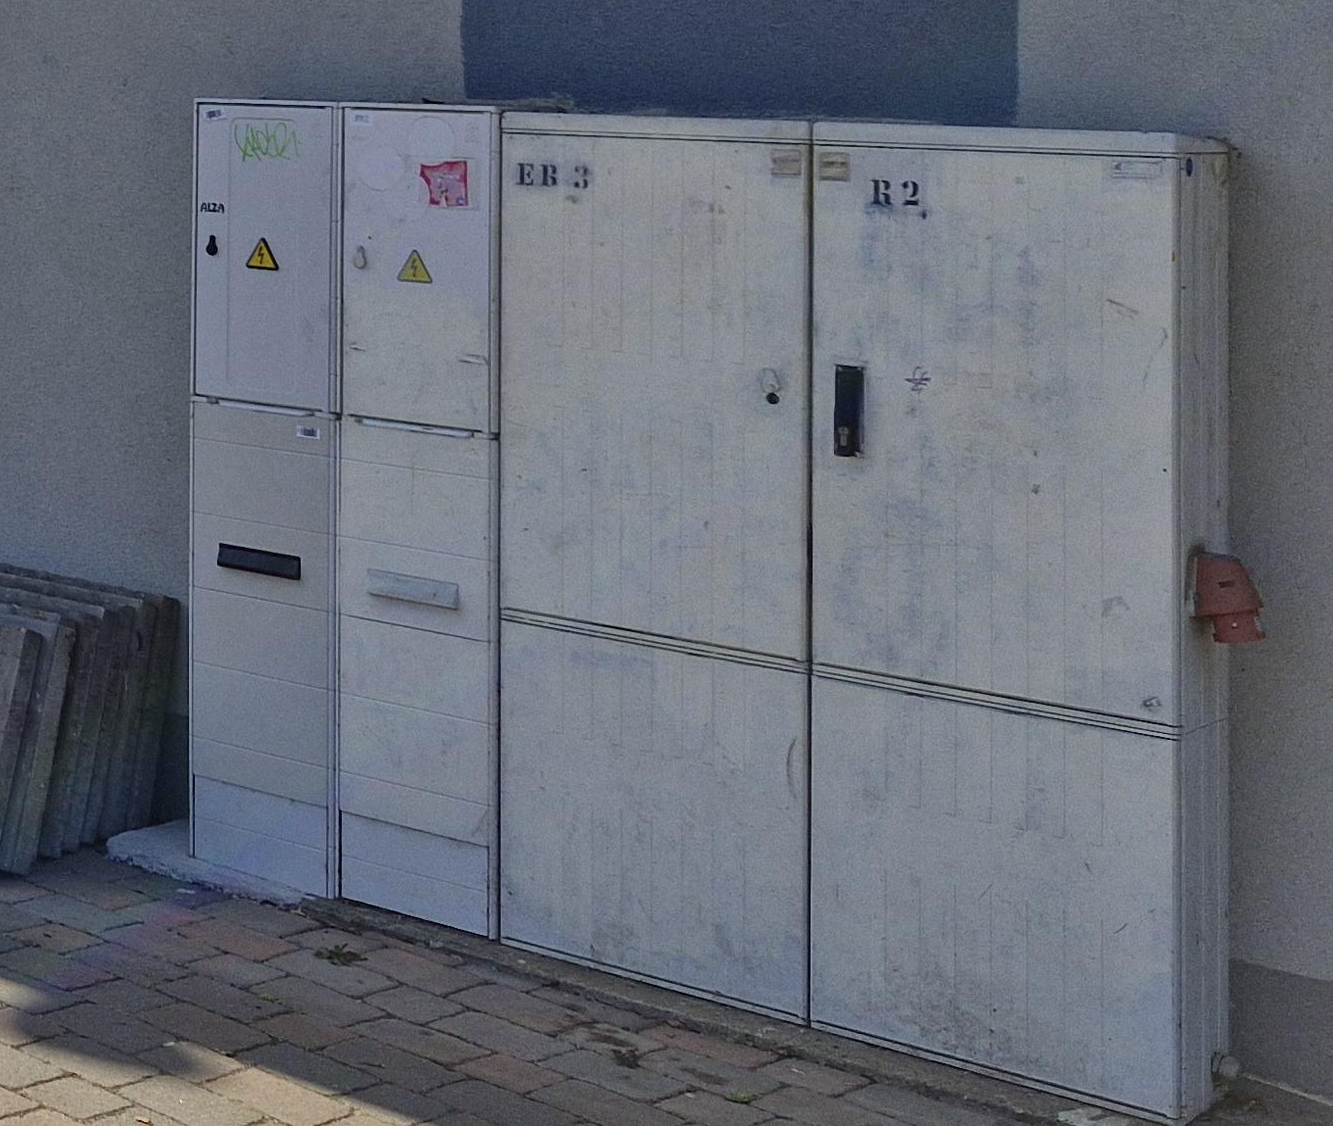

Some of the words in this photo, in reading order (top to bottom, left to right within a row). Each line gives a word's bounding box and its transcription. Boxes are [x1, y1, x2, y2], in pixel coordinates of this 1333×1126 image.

[573, 165, 589, 189] 3
[901, 180, 919, 206] 2
[200, 202, 225, 214] ALZA
